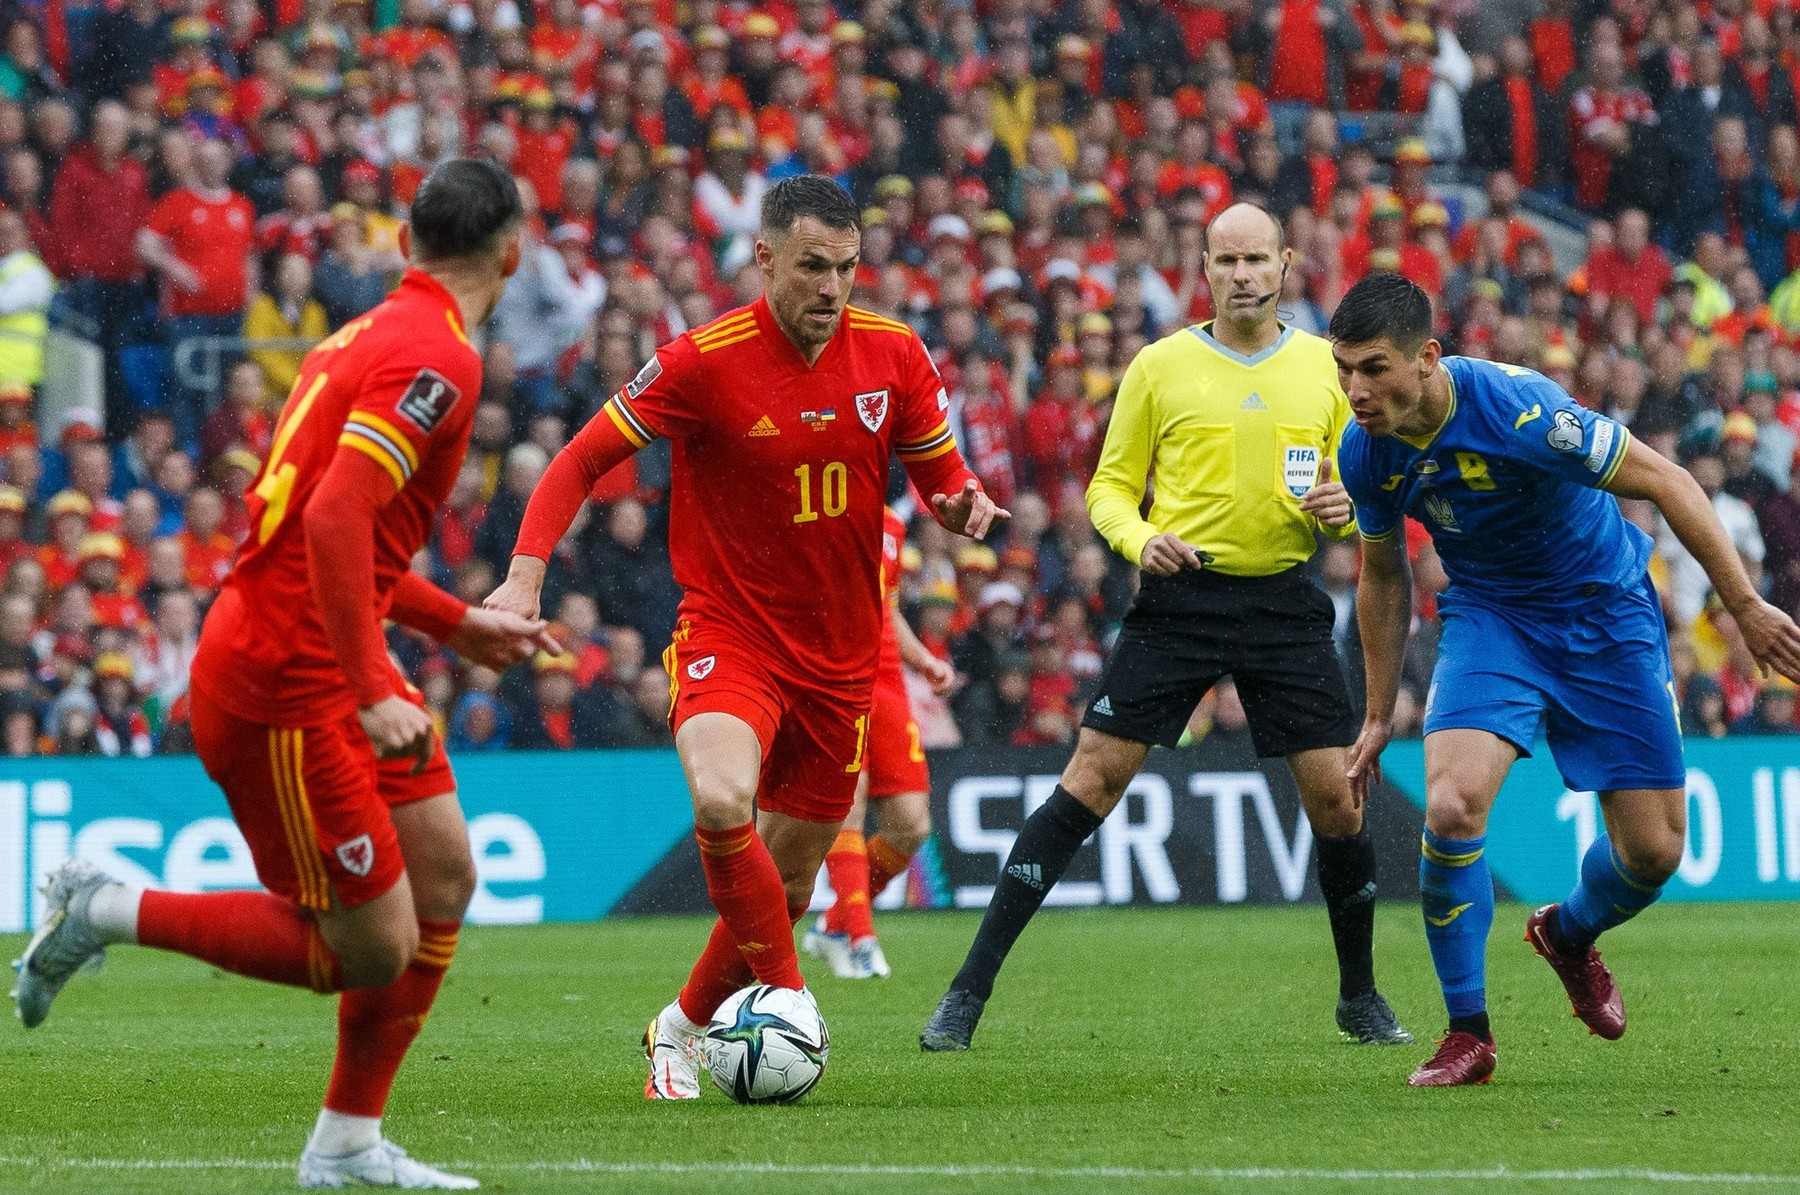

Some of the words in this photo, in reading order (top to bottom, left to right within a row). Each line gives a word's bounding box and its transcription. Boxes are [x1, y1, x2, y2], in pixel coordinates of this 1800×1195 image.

[748, 428, 781, 437] adidas
[1288, 450, 1315, 462] FIFA
[793, 461, 847, 523] 10
[1556, 767, 1724, 888] 10
[1007, 864, 1045, 891] adidas
